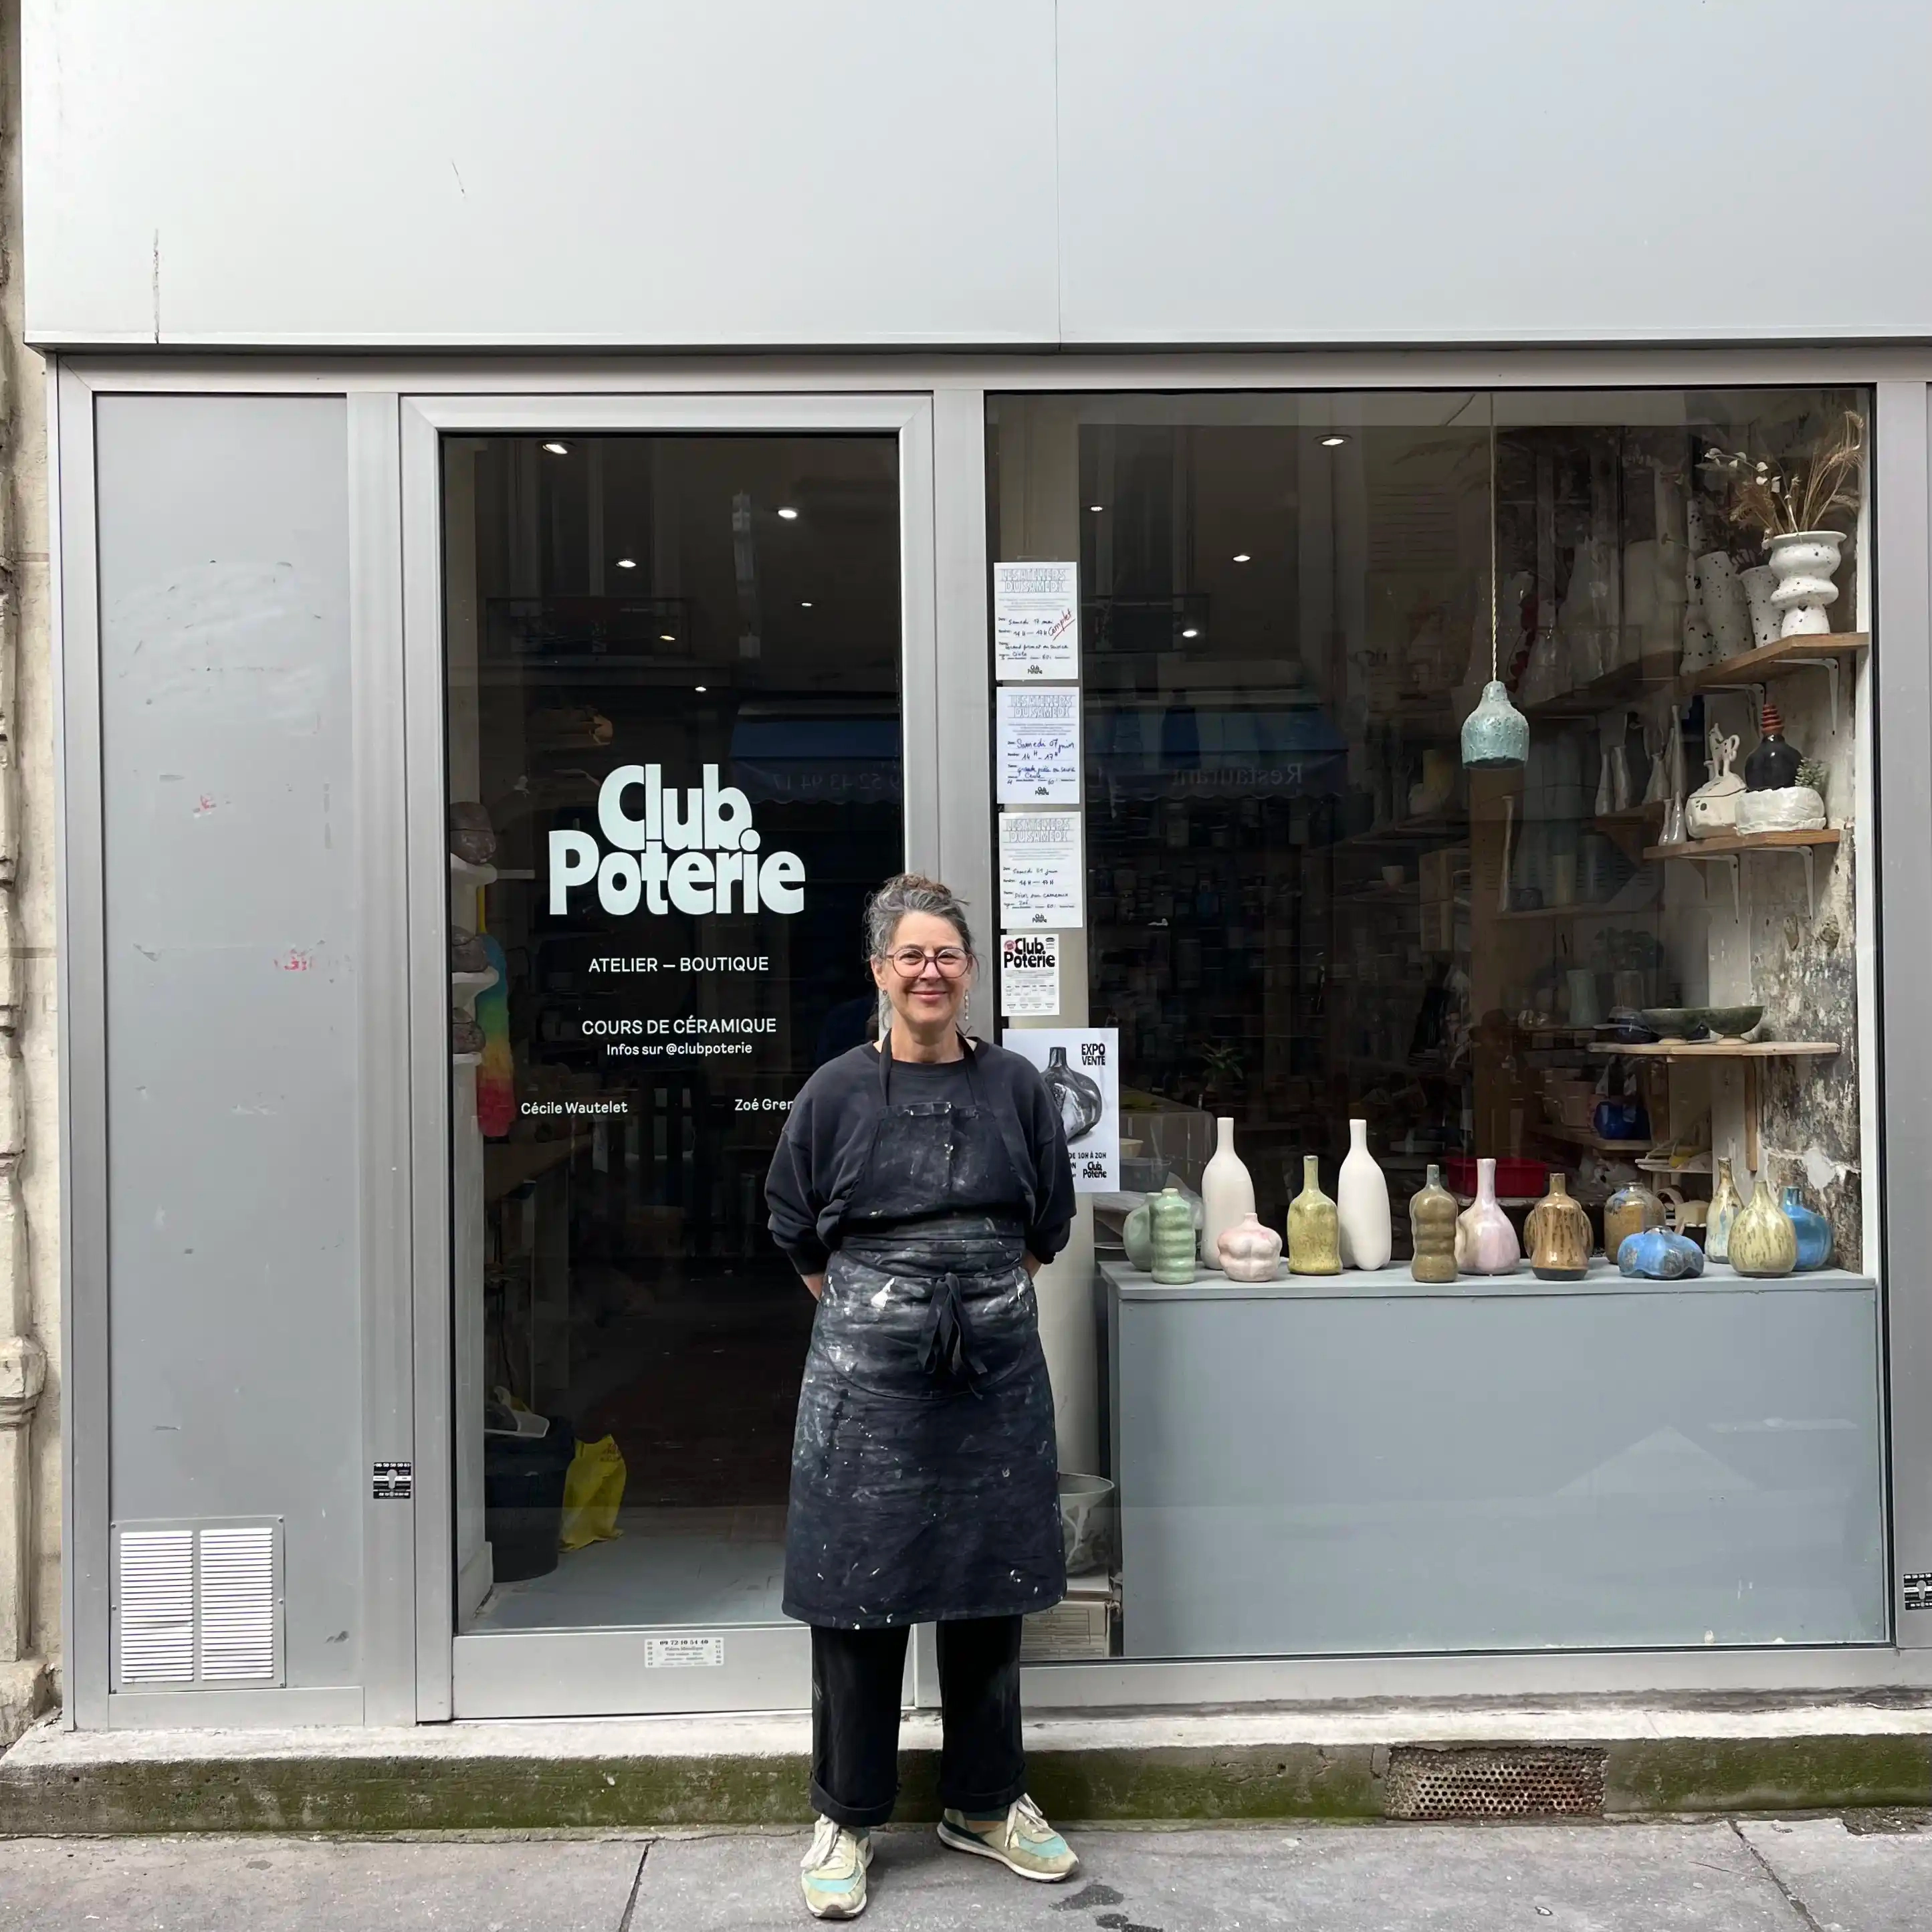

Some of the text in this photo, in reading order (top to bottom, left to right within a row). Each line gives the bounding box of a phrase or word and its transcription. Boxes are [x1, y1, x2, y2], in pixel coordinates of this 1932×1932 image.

[1016, 738, 1046, 748] Samedi
[1049, 738, 1058, 747] 07
[548, 829, 806, 916] Poterie
[1014, 938, 1044, 955] Club
[588, 958, 657, 972] ATELIER
[680, 956, 768, 972] BOUTIQUE
[1004, 950, 1055, 968] Poterie
[582, 1014, 776, 1035] COURS DE CÉRAMIQUE
[607, 1042, 752, 1057] Infos sur @clubpoterie
[1081, 1043, 1105, 1055] EXPO
[1082, 1056, 1105, 1065] VENTE
[521, 1100, 628, 1115] Cécile Wautelet
[734, 1098, 759, 1111] Zoé
[1083, 1168, 1107, 1178] Poterie
